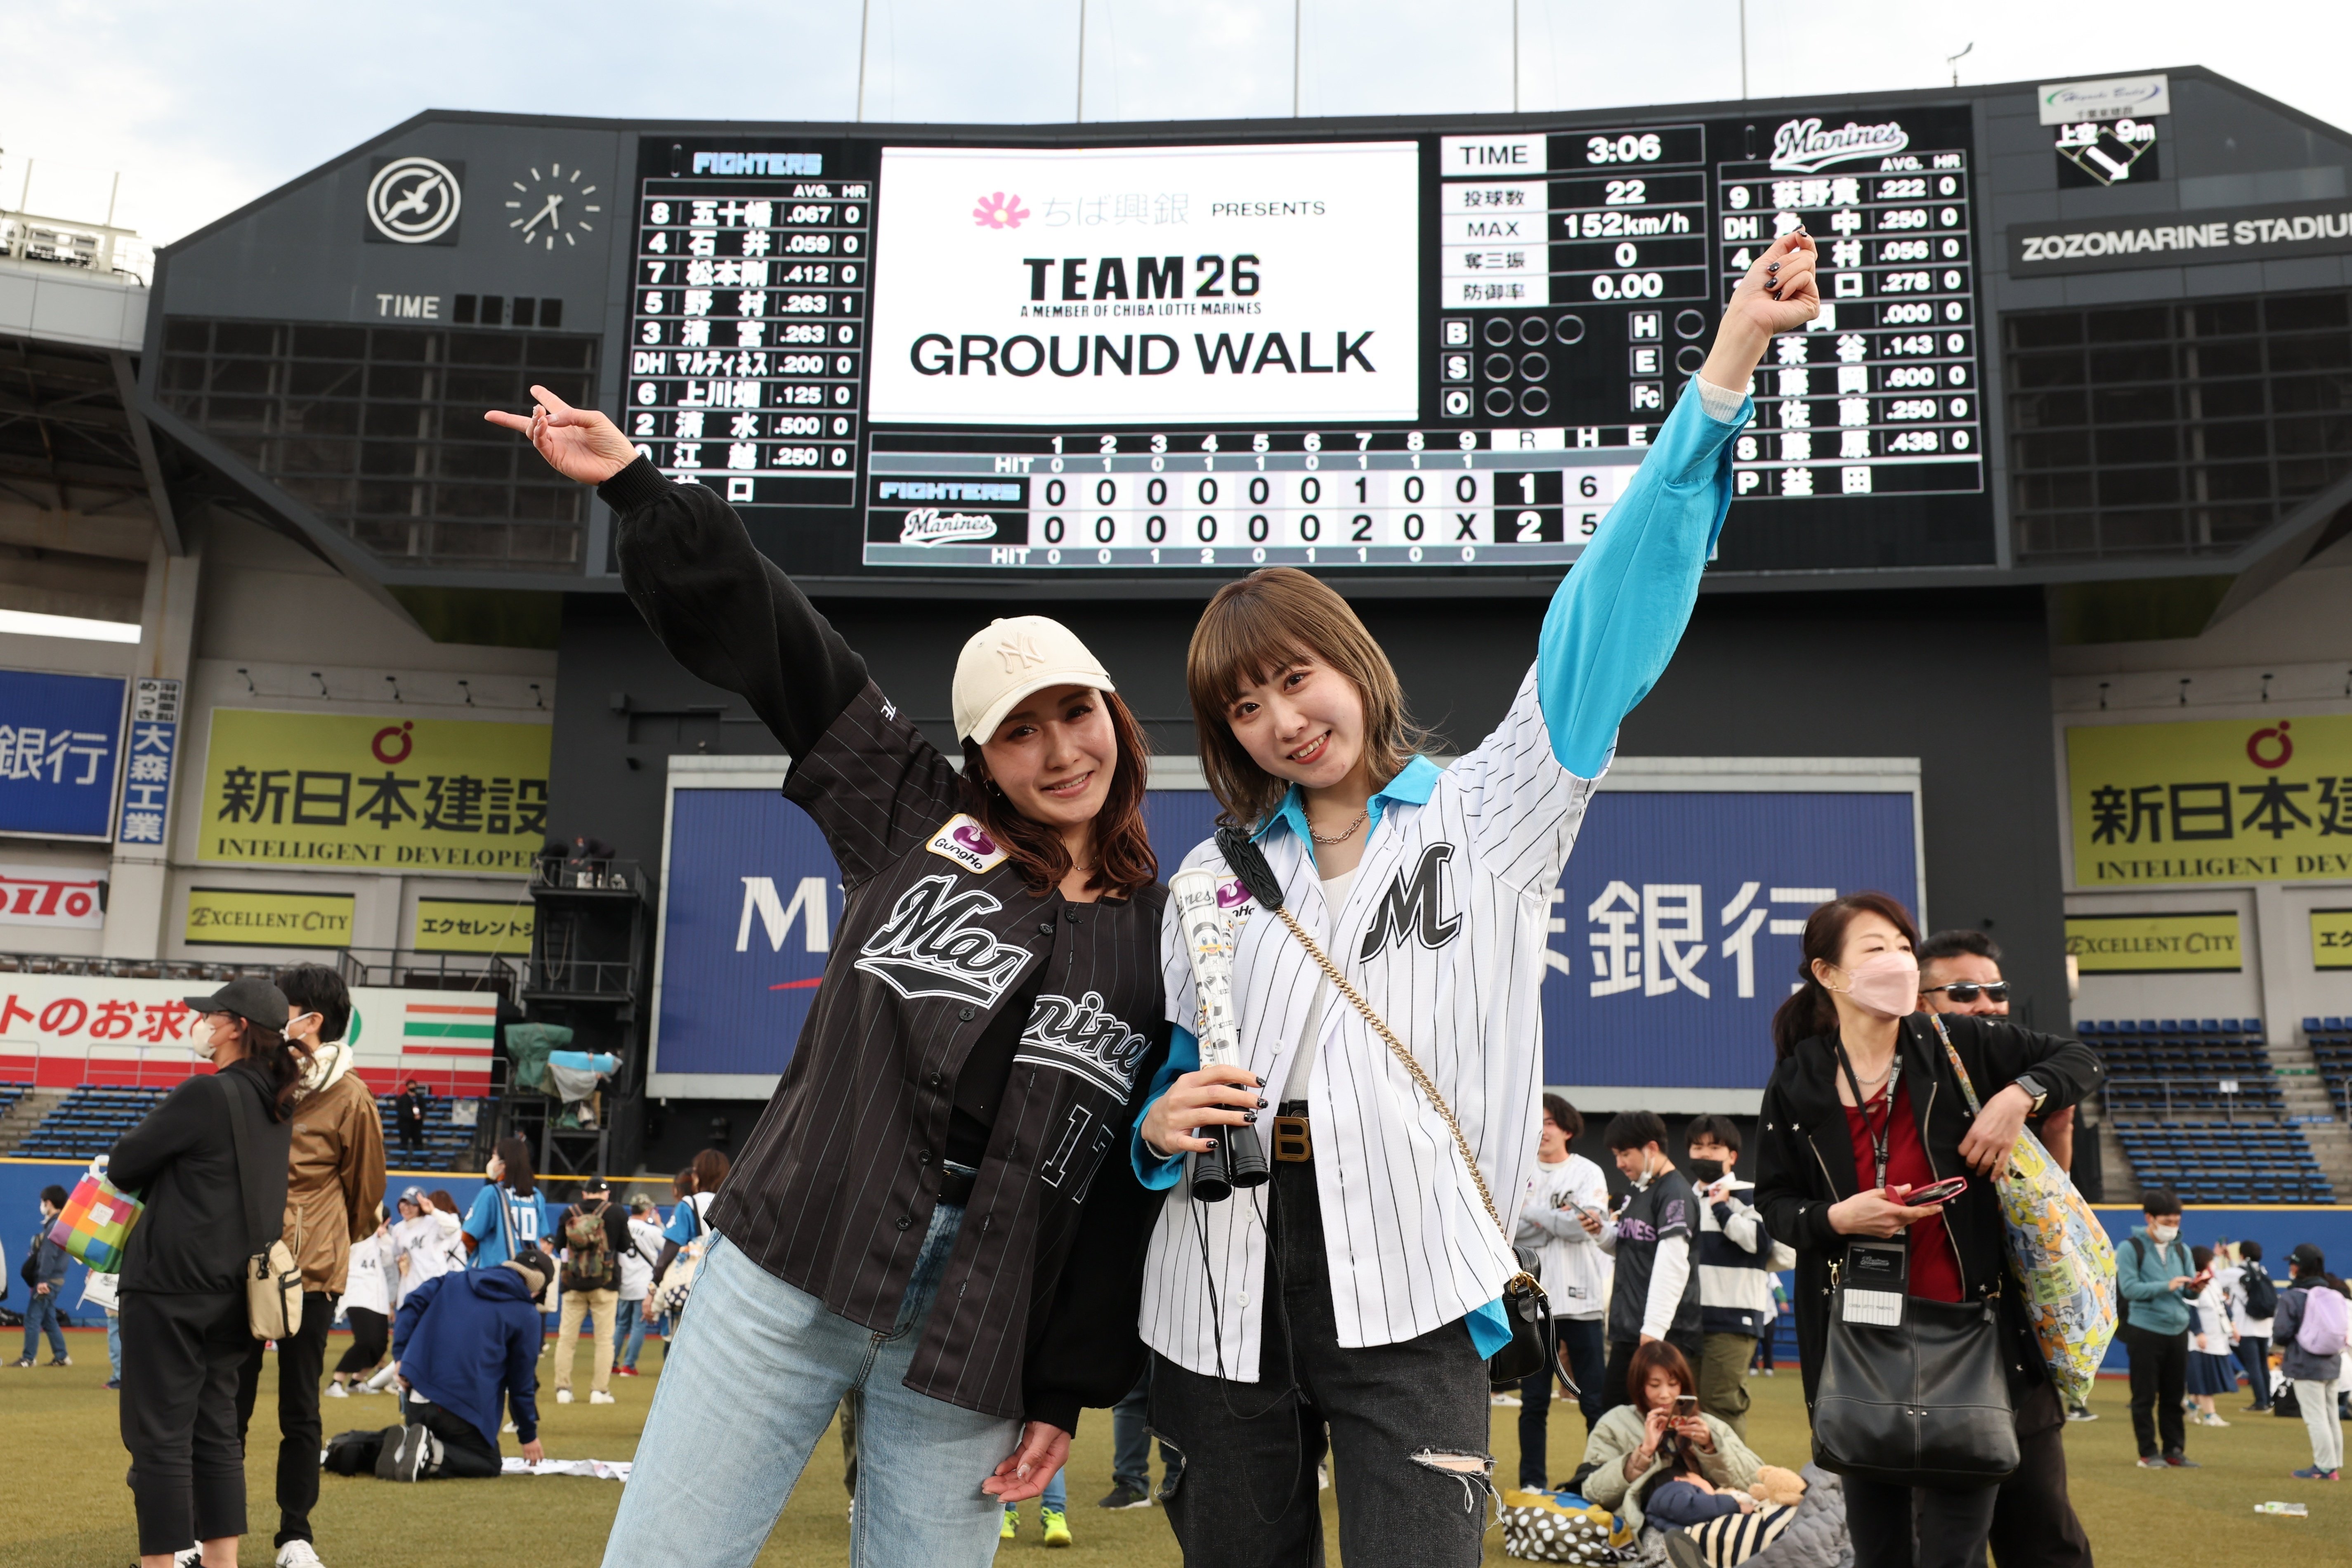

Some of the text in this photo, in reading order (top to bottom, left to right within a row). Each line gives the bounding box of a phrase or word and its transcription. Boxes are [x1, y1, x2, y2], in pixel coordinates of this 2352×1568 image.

[1460, 134, 1661, 164] TIME 3:06
[1769, 118, 1909, 172] Marines
[693, 152, 822, 175] FIGHTERS
[1880, 155, 1960, 172] AVG. HR
[793, 185, 866, 198] AVG. HR
[1464, 180, 1646, 207] 投球数 22
[1730, 186, 1749, 208] 9
[1877, 179, 1926, 198] .222
[651, 203, 669, 224] 8
[787, 206, 831, 223] .067
[1042, 193, 1326, 227] ちば興銀 PRESENTS
[1468, 212, 1689, 238] MAX 152km/h
[1724, 217, 1757, 239] DH
[1878, 210, 1927, 229] .250
[649, 233, 667, 253] 4
[786, 236, 830, 253] .059
[2022, 212, 2352, 262] ZOZOMARINE STADIU
[1615, 243, 1637, 267] 0
[1731, 241, 1928, 269] 4 .056
[647, 262, 666, 283] 7
[784, 266, 829, 282] .412
[1881, 272, 1930, 292] .278
[1464, 273, 1663, 301] 防御率 0.00
[376, 294, 440, 319] TIME
[645, 292, 663, 313] 5
[782, 295, 827, 312] .263
[1021, 302, 1261, 317] A MEMBER OF CHIBA LOTTE MARINES
[1882, 304, 1932, 324] .000
[642, 322, 661, 344] 3
[780, 326, 825, 342] .263
[1447, 315, 1656, 345] B H
[909, 331, 1378, 378] GROUND WALK
[1883, 335, 1933, 355] .143
[634, 351, 823, 377] DH マルティネス .200
[1448, 350, 1656, 379] S E
[1885, 368, 1935, 387] .600
[638, 383, 656, 405] 6
[776, 387, 821, 404] .125
[1635, 386, 1660, 409] Fc
[1887, 399, 1936, 419] .250
[635, 414, 654, 436] 2
[775, 417, 820, 435] .500
[1052, 426, 1647, 454] 1 2 3 4 5 6 7 8 9 R H E
[1737, 437, 1757, 460] 8
[1888, 432, 1938, 451] .438
[773, 448, 818, 466] .250
[995, 457, 1034, 473] HIT
[880, 473, 1597, 506] FIGHTERS 0 0 0 0 0 0 1 0 0 1 6
[1738, 471, 1759, 494] P
[900, 508, 1597, 548] Marines 0 0 0 0 0 0 2 0 X 2 5
[991, 548, 1030, 564] HIT
[0, 725, 108, 784] 銀行
[124, 725, 172, 841] 大森工業
[218, 766, 547, 835] 新日本建設
[218, 838, 387, 862] INTELLIGENT
[934, 836, 983, 871] GungHo
[2097, 856, 2283, 879] INTELLIGENT
[1360, 842, 1462, 964] M
[191, 908, 349, 931] EXCELLENT CITY
[2185, 933, 2236, 954] CITY
[0, 994, 196, 1043] トのお求
[1274, 1116, 1311, 1162] B
[361, 1258, 375, 1269] 44
